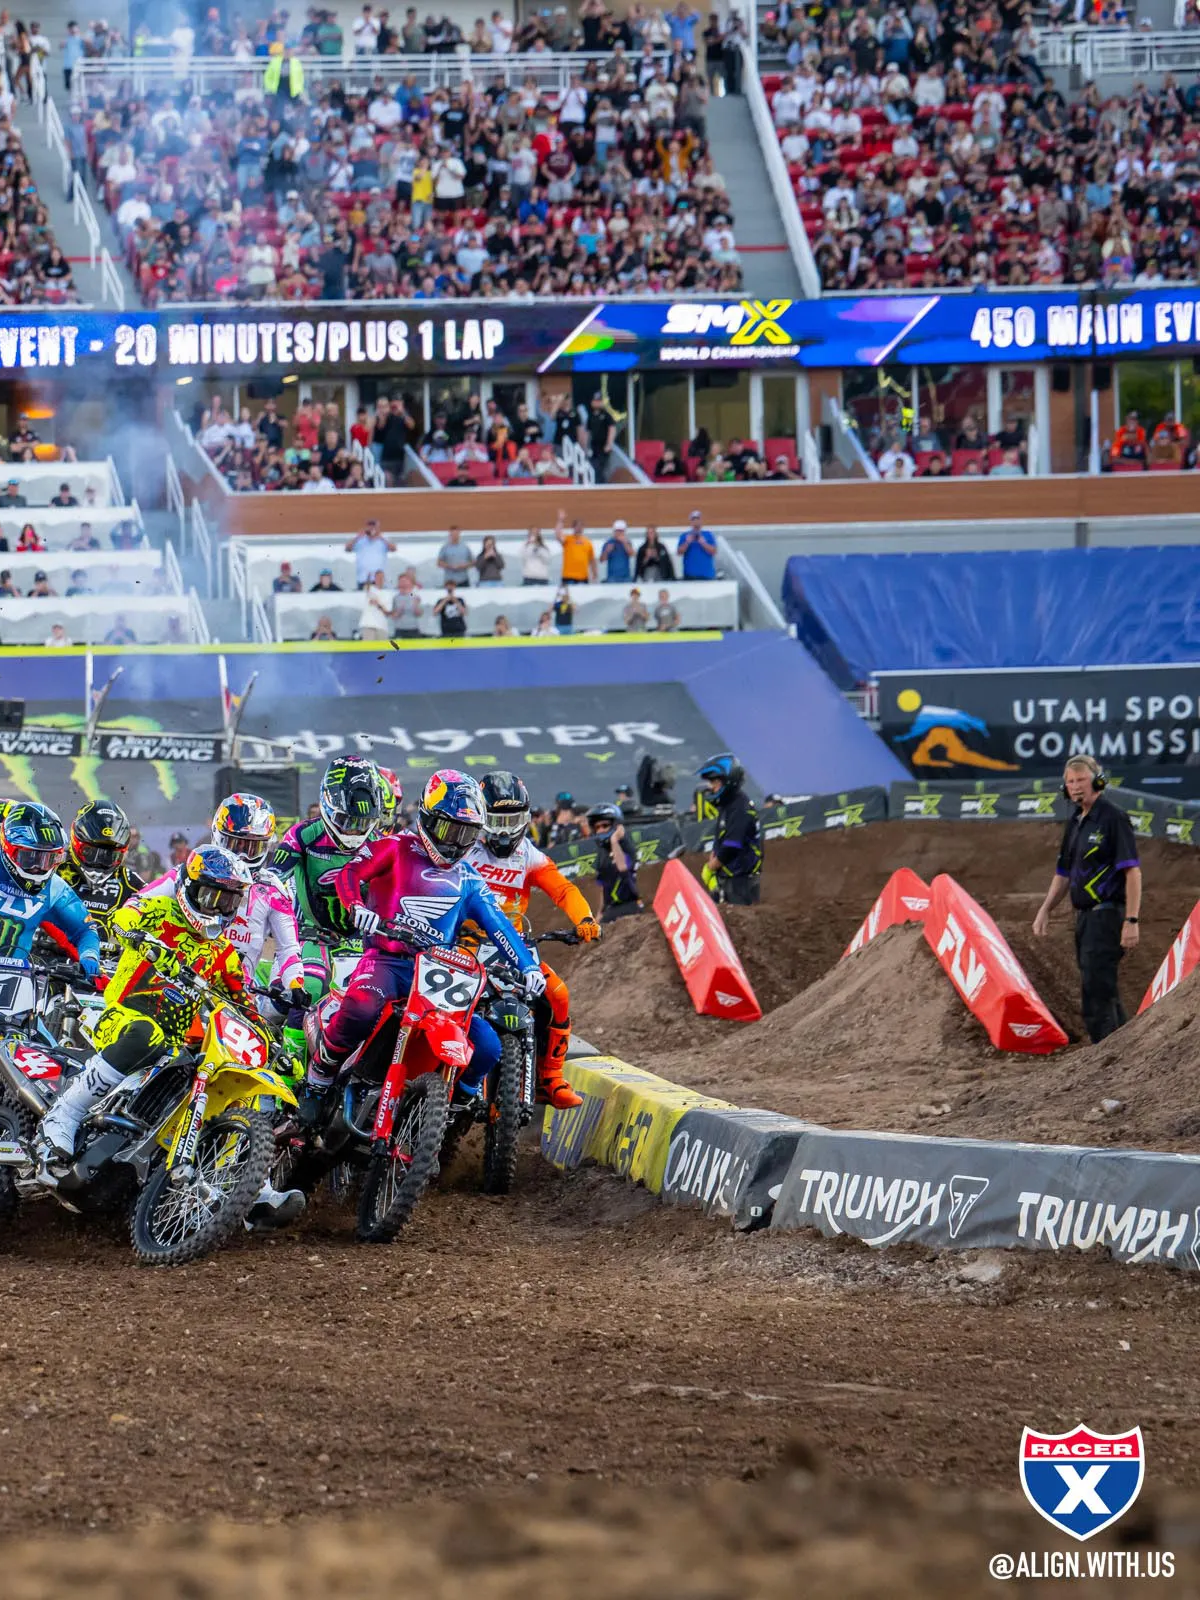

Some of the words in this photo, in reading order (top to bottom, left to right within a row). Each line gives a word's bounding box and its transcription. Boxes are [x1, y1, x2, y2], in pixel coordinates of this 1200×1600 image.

[114, 324, 157, 366] 20
[168, 319, 409, 365] MINUTES/PLUS
[418, 320, 434, 361] 1
[444, 318, 505, 361] LAP
[661, 299, 793, 345] SMX
[970, 306, 1036, 348] 450
[1047, 303, 1143, 346] MAIN
[1013, 698, 1107, 724] UTAH
[1126, 694, 1200, 722] SPO
[472, 861, 524, 884] LEATT
[83, 900, 109, 911] qvarna
[394, 912, 445, 941] HONDA
[433, 951, 473, 967] RENTHAL
[493, 930, 520, 966] HONDA
[424, 968, 472, 1006] 96
[223, 1019, 262, 1067] 94
[523, 1053, 534, 1105] DUNLOP
[376, 1081, 393, 1128] DUNLOP
[184, 1110, 202, 1160] DUNLOP
[800, 1169, 946, 1246] TRIUMPH
[1016, 1191, 1189, 1264] TRIUMPH
